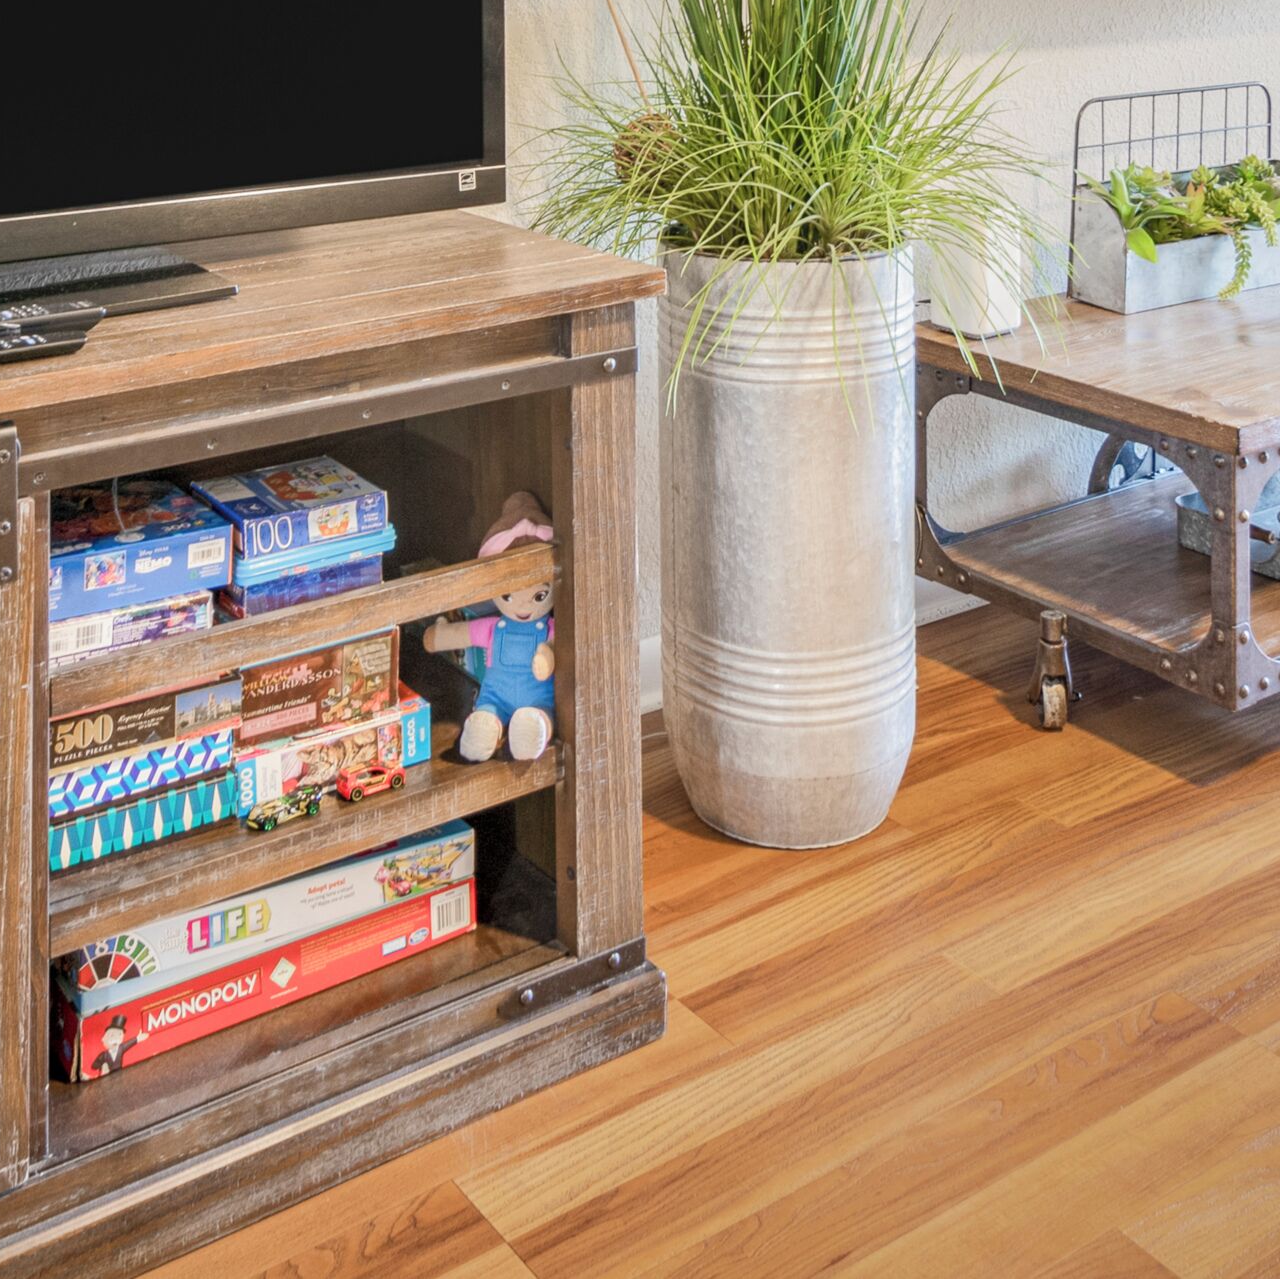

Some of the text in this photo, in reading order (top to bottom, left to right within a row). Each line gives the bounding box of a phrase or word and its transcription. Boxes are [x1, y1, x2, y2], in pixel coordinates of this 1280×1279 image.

[249, 516, 293, 554] 100
[55, 714, 114, 754] 500
[85, 744, 113, 756] PIECES
[240, 768, 254, 807] 1000
[191, 903, 265, 950] LIFE
[147, 974, 257, 1032] MONOPOLY
